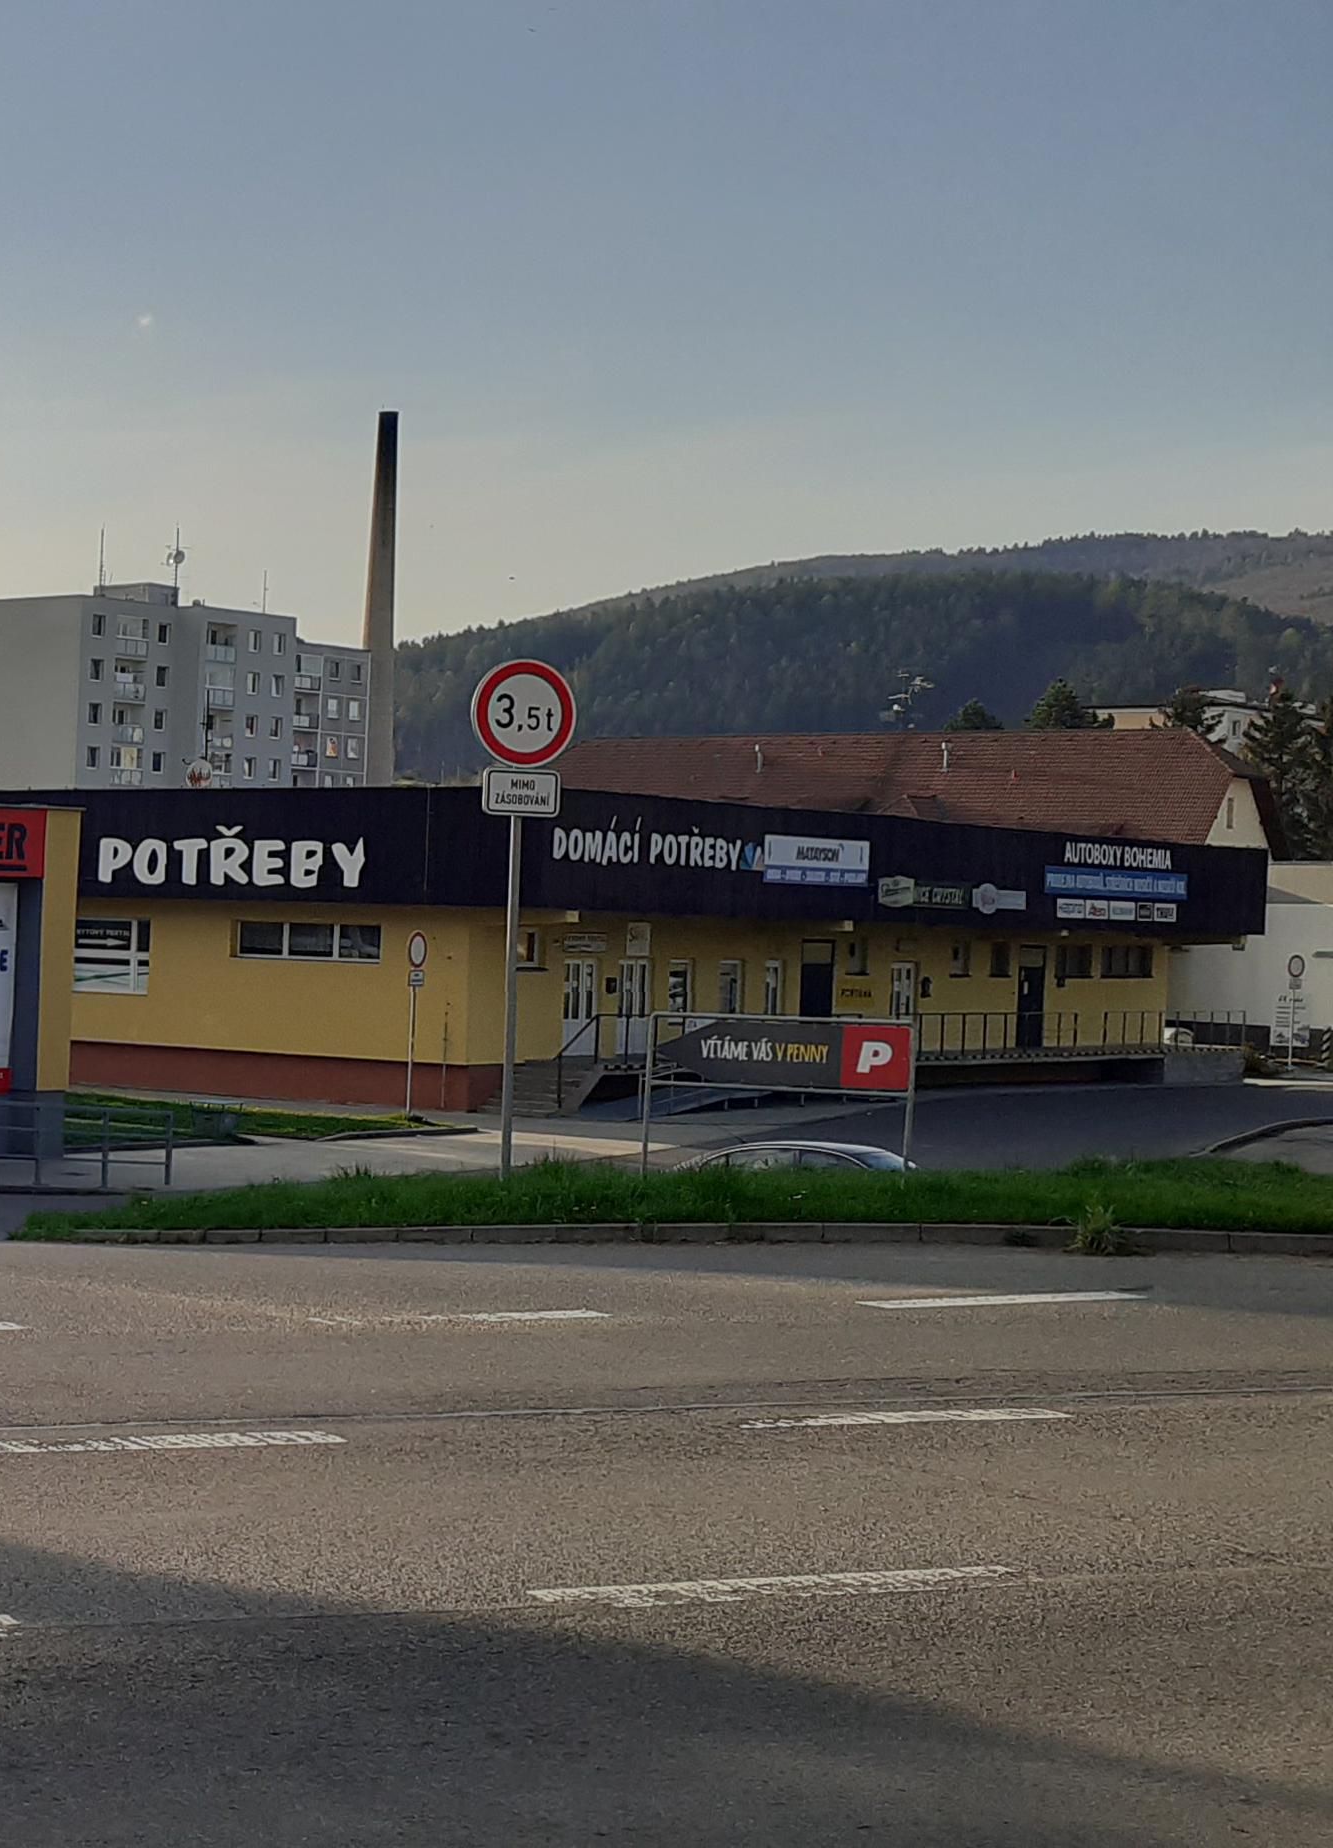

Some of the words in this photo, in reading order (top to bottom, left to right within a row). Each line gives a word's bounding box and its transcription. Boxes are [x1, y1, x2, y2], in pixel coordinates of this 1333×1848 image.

[495, 791, 550, 806] ZÁSOBOVÁNÍ
[510, 779, 535, 790] MIMO
[97, 825, 366, 888] POTŘEBY
[552, 816, 641, 866] DOMÁCÍ
[649, 825, 743, 872] POTŘEBY
[1064, 841, 1123, 866] AUTOBOXY
[1124, 846, 1172, 870] BOHEMIA
[701, 1035, 751, 1063] VÍTÁME
[751, 1036, 773, 1062] VÁS
[775, 1043, 786, 1062] V
[786, 1043, 830, 1065] PENNY
[855, 1042, 893, 1074] P
